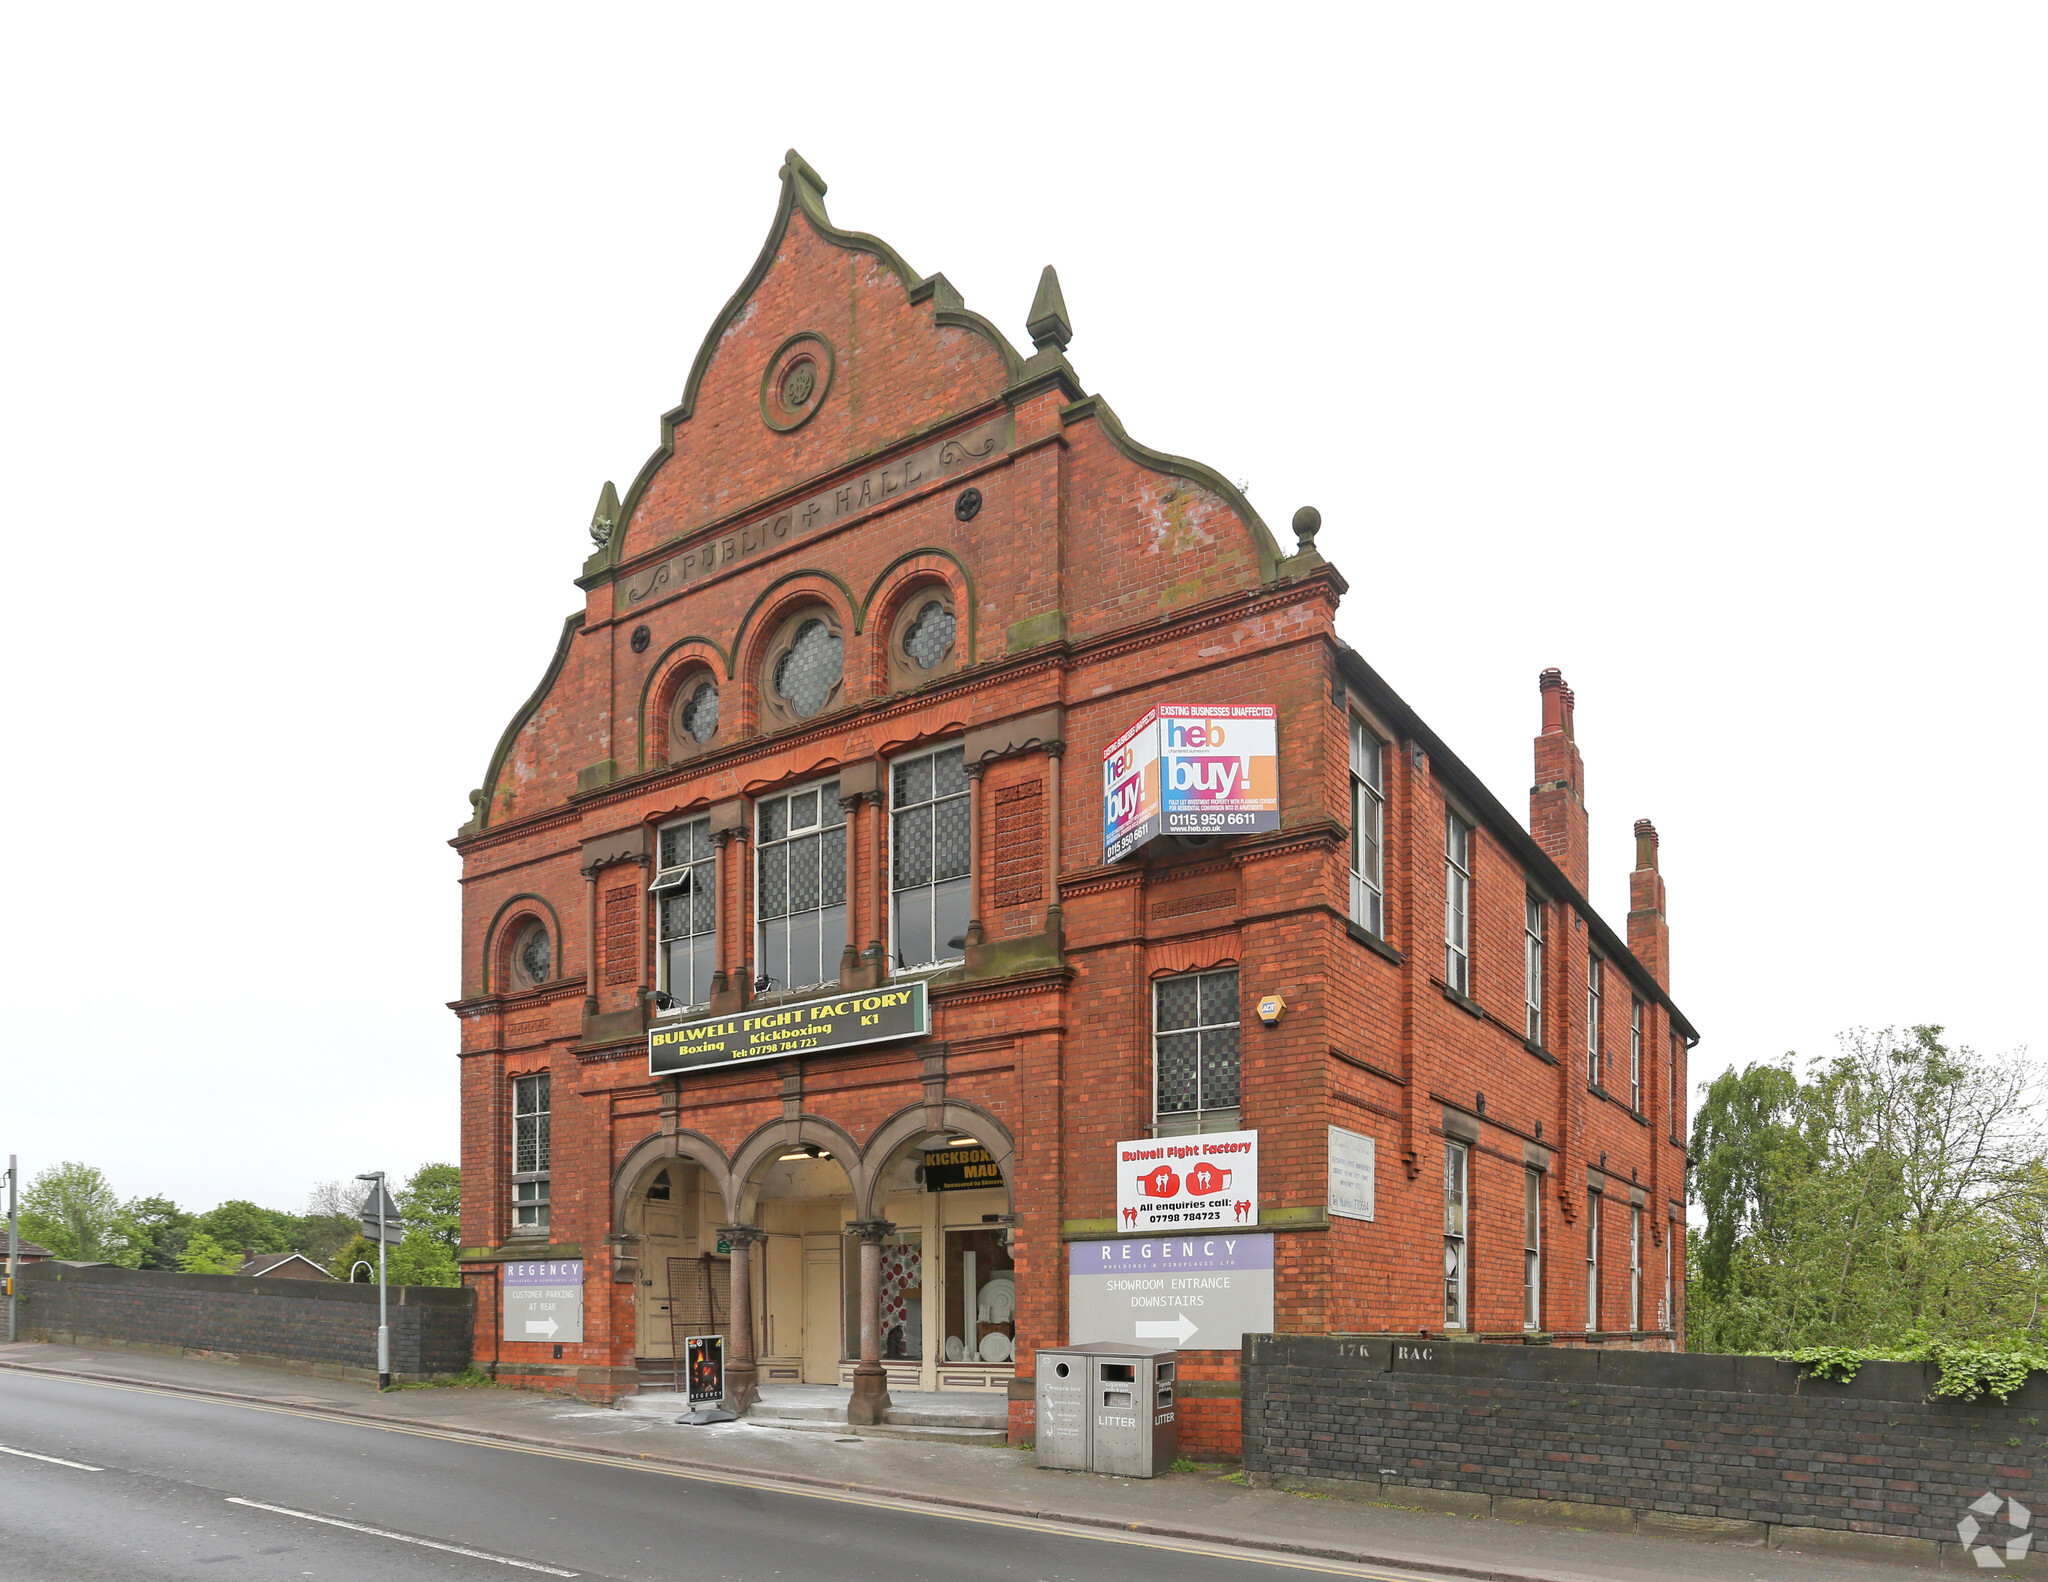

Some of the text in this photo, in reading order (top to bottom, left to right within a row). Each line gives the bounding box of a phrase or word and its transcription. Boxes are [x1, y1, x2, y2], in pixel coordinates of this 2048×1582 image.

[683, 461, 922, 579] PUBLIC HALL
[1160, 706, 1274, 716] EXISTING BUSINESSES UNAFFECTED
[1168, 719, 1225, 747] heb
[1107, 744, 1133, 785] heb
[1168, 756, 1250, 799] buy!
[1107, 769, 1146, 825] buy!
[1169, 813, 1255, 825] 0115 950 6611
[1107, 822, 1148, 858] 0115 950 6611
[1262, 1003, 1275, 1011] ADT
[652, 990, 912, 1047] BULWELL FIGHT FACTORY
[679, 1014, 879, 1056] Boxing Kickboxing K1
[731, 1037, 817, 1059] Tel: 07798 784 723
[925, 1149, 994, 1167] KICKBOX
[1122, 1141, 1252, 1162] Bulwell Fight Factory
[1139, 1198, 1232, 1213] All enquiries call:
[1149, 1211, 1221, 1223] 07798 784723
[1101, 1240, 1237, 1260] REGENCY
[508, 1263, 579, 1276] REGENCY
[1107, 1277, 1231, 1291] SHOWROOM ENTRANCE
[512, 1290, 574, 1299] CUSTOMER PARKING
[1131, 1295, 1204, 1307] DOWNSTAIRS
[528, 1303, 556, 1311] AT REAR
[691, 1391, 722, 1399] REGENCY
[1098, 1415, 1136, 1428] LITTER
[1155, 1411, 1175, 1426] LITTER
